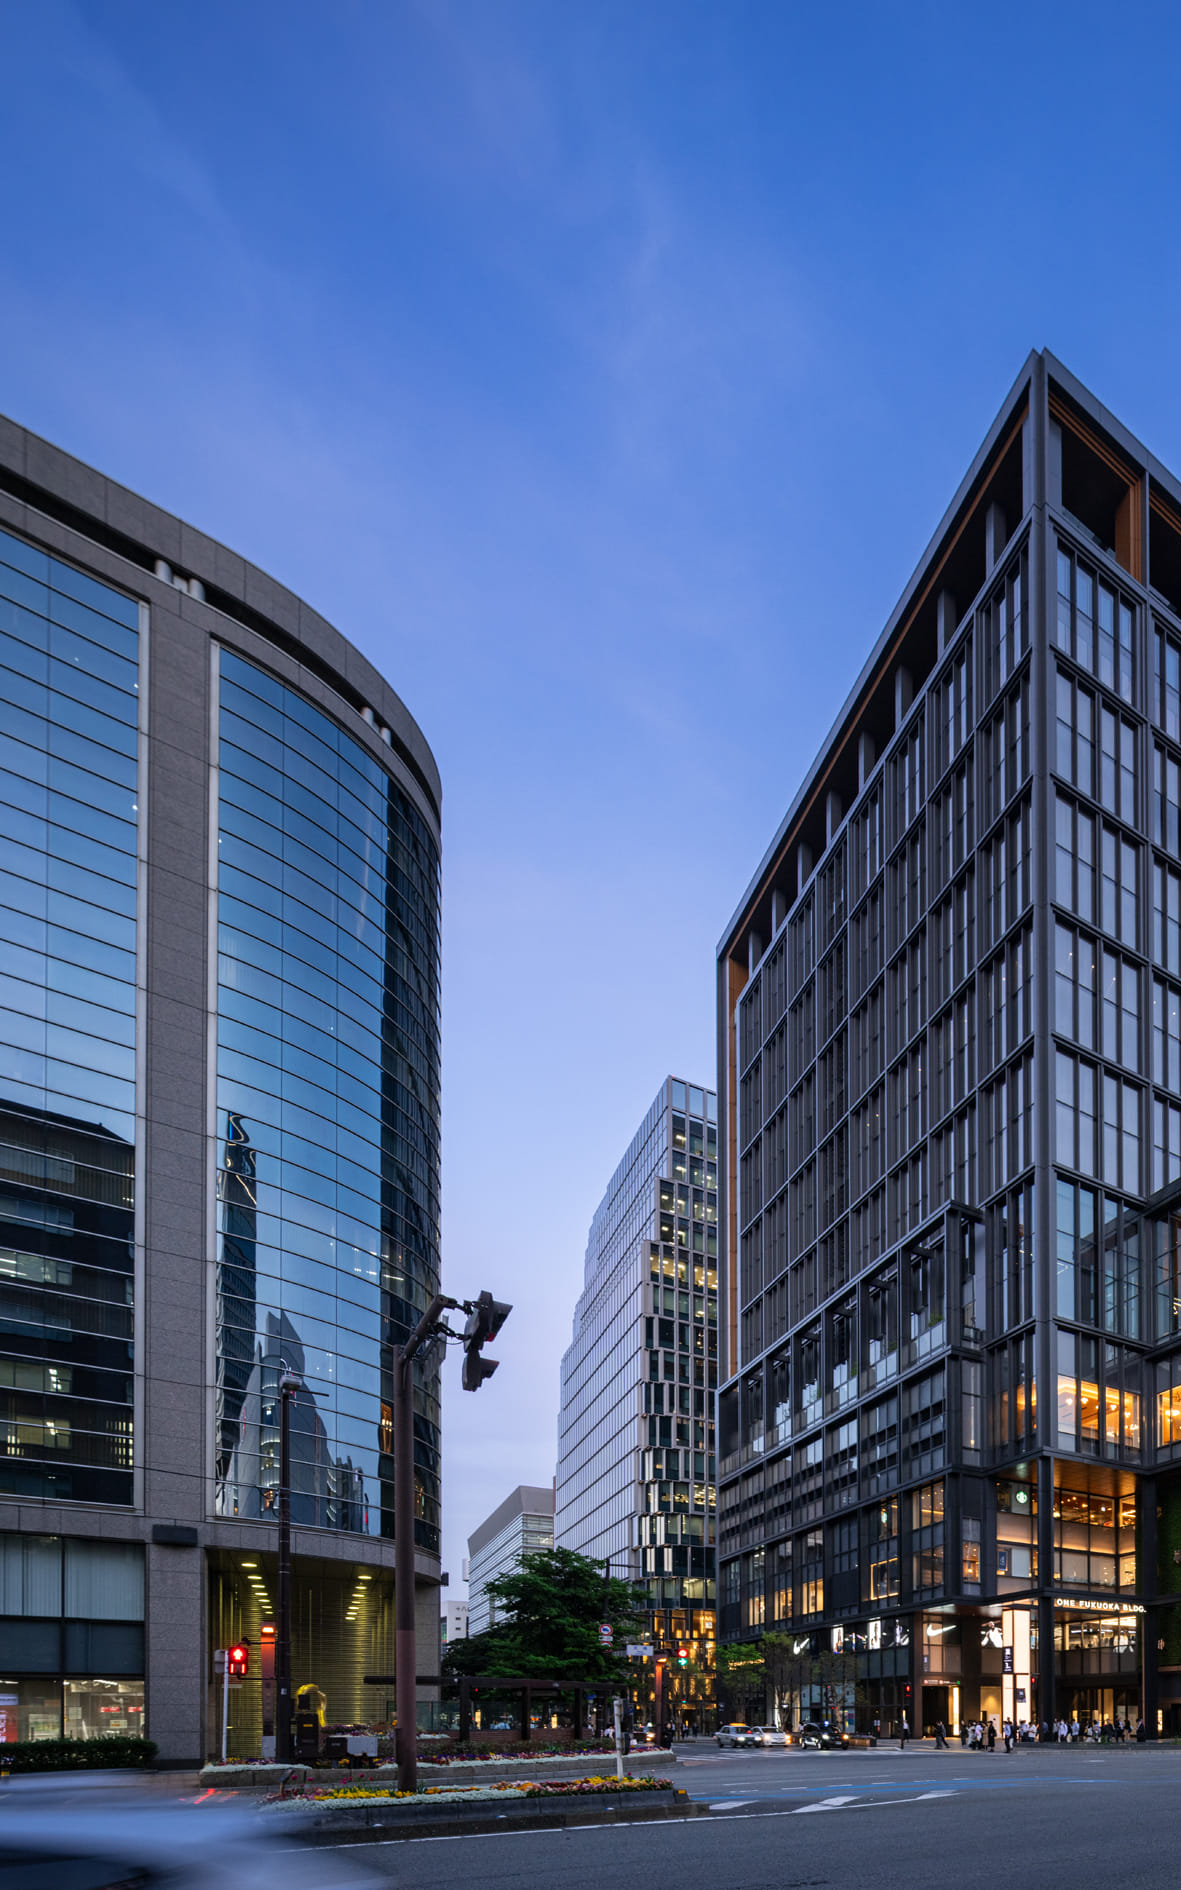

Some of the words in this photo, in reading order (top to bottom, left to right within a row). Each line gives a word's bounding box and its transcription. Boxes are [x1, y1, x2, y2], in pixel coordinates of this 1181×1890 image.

[1057, 1598, 1075, 1606] ONE
[1080, 1600, 1120, 1610] FUKUOKA
[1122, 1604, 1147, 1613] BLDG.
